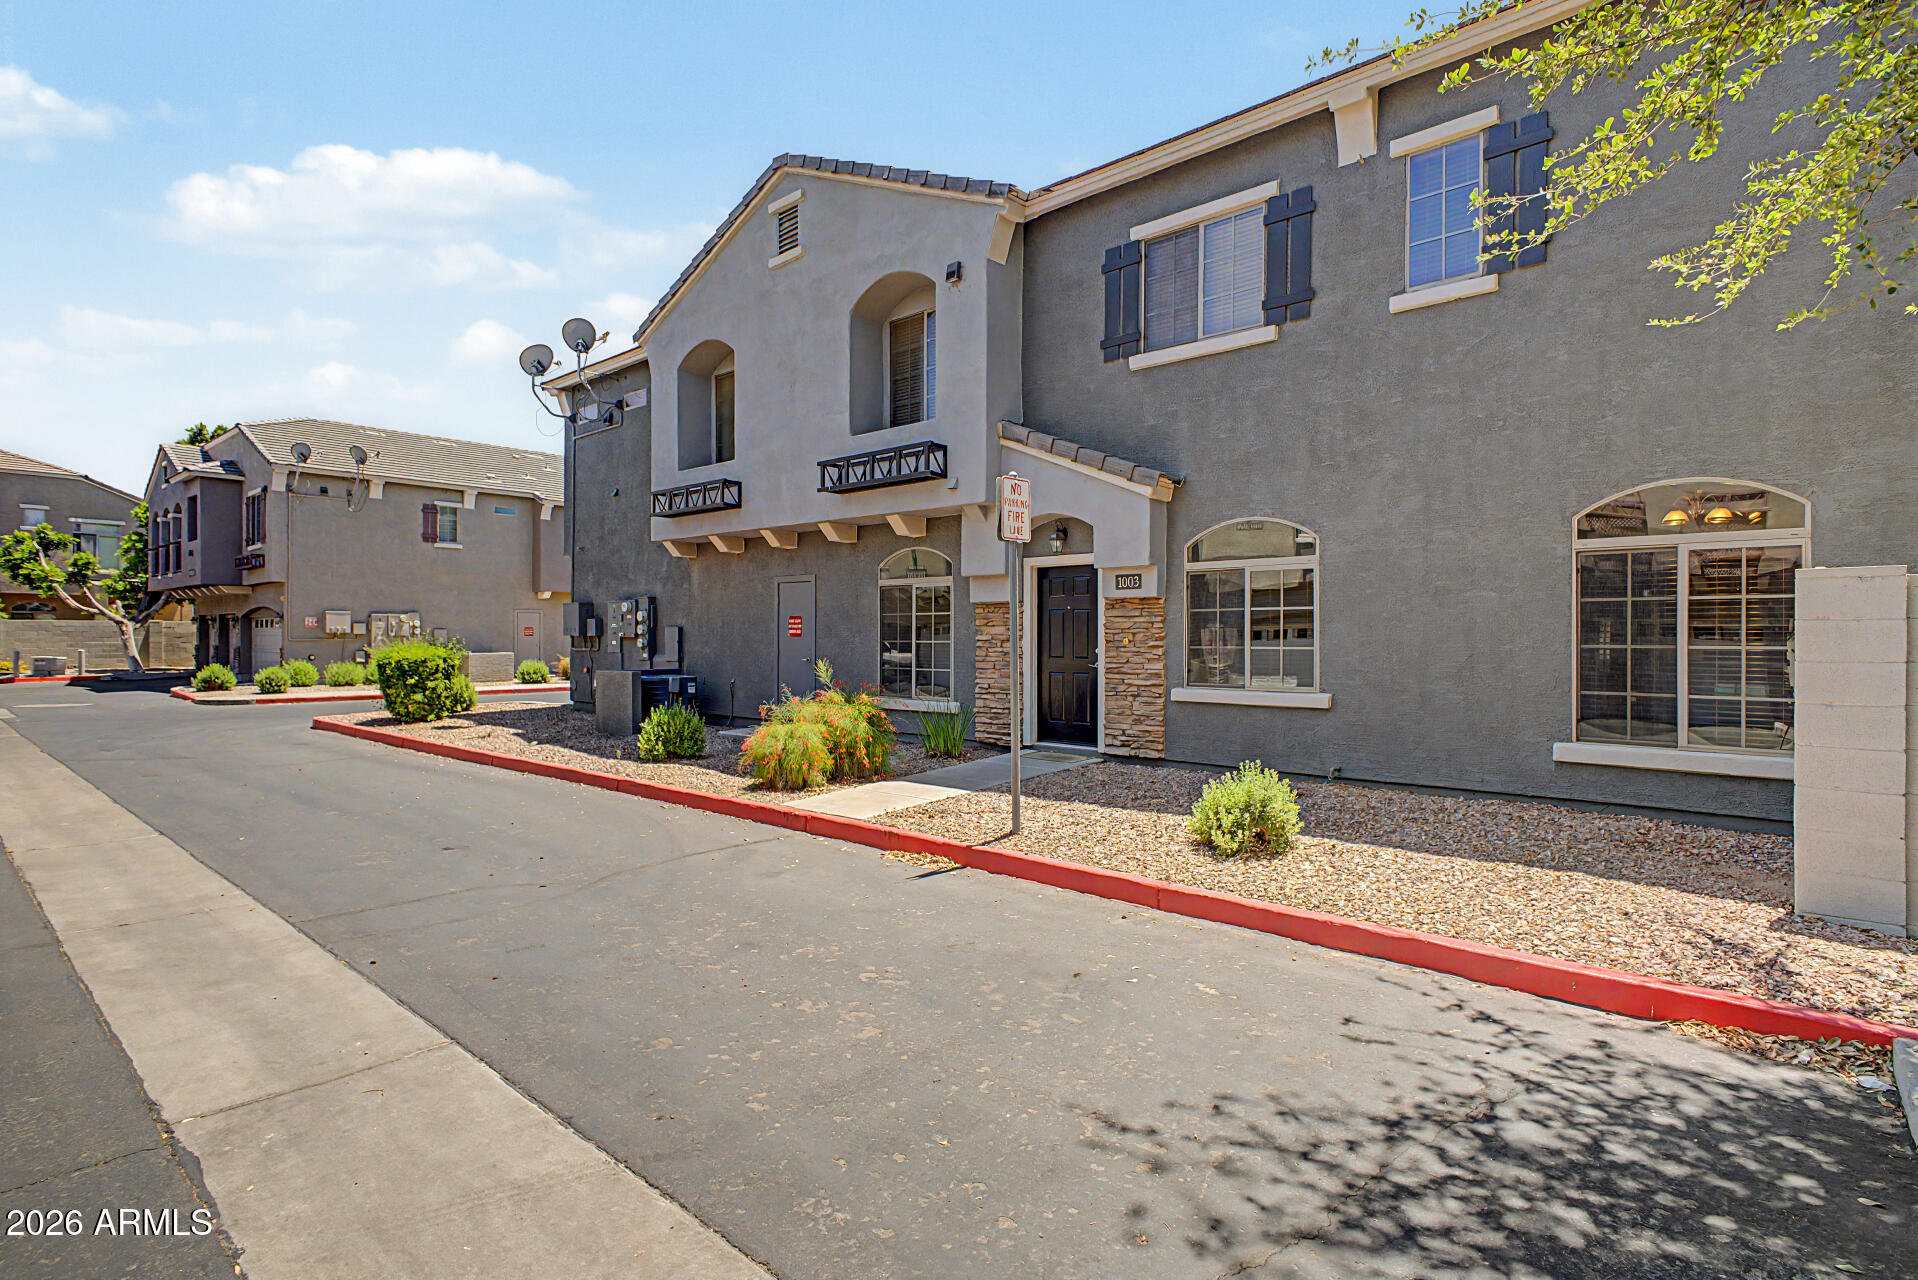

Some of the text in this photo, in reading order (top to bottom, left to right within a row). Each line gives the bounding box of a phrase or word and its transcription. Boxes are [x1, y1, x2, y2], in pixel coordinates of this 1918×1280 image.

[1010, 483, 1022, 496] NO
[1004, 497, 1028, 510] PARKING
[1007, 510, 1025, 524] FIRE
[1009, 525, 1024, 536] LANE
[1117, 575, 1140, 588] 1003
